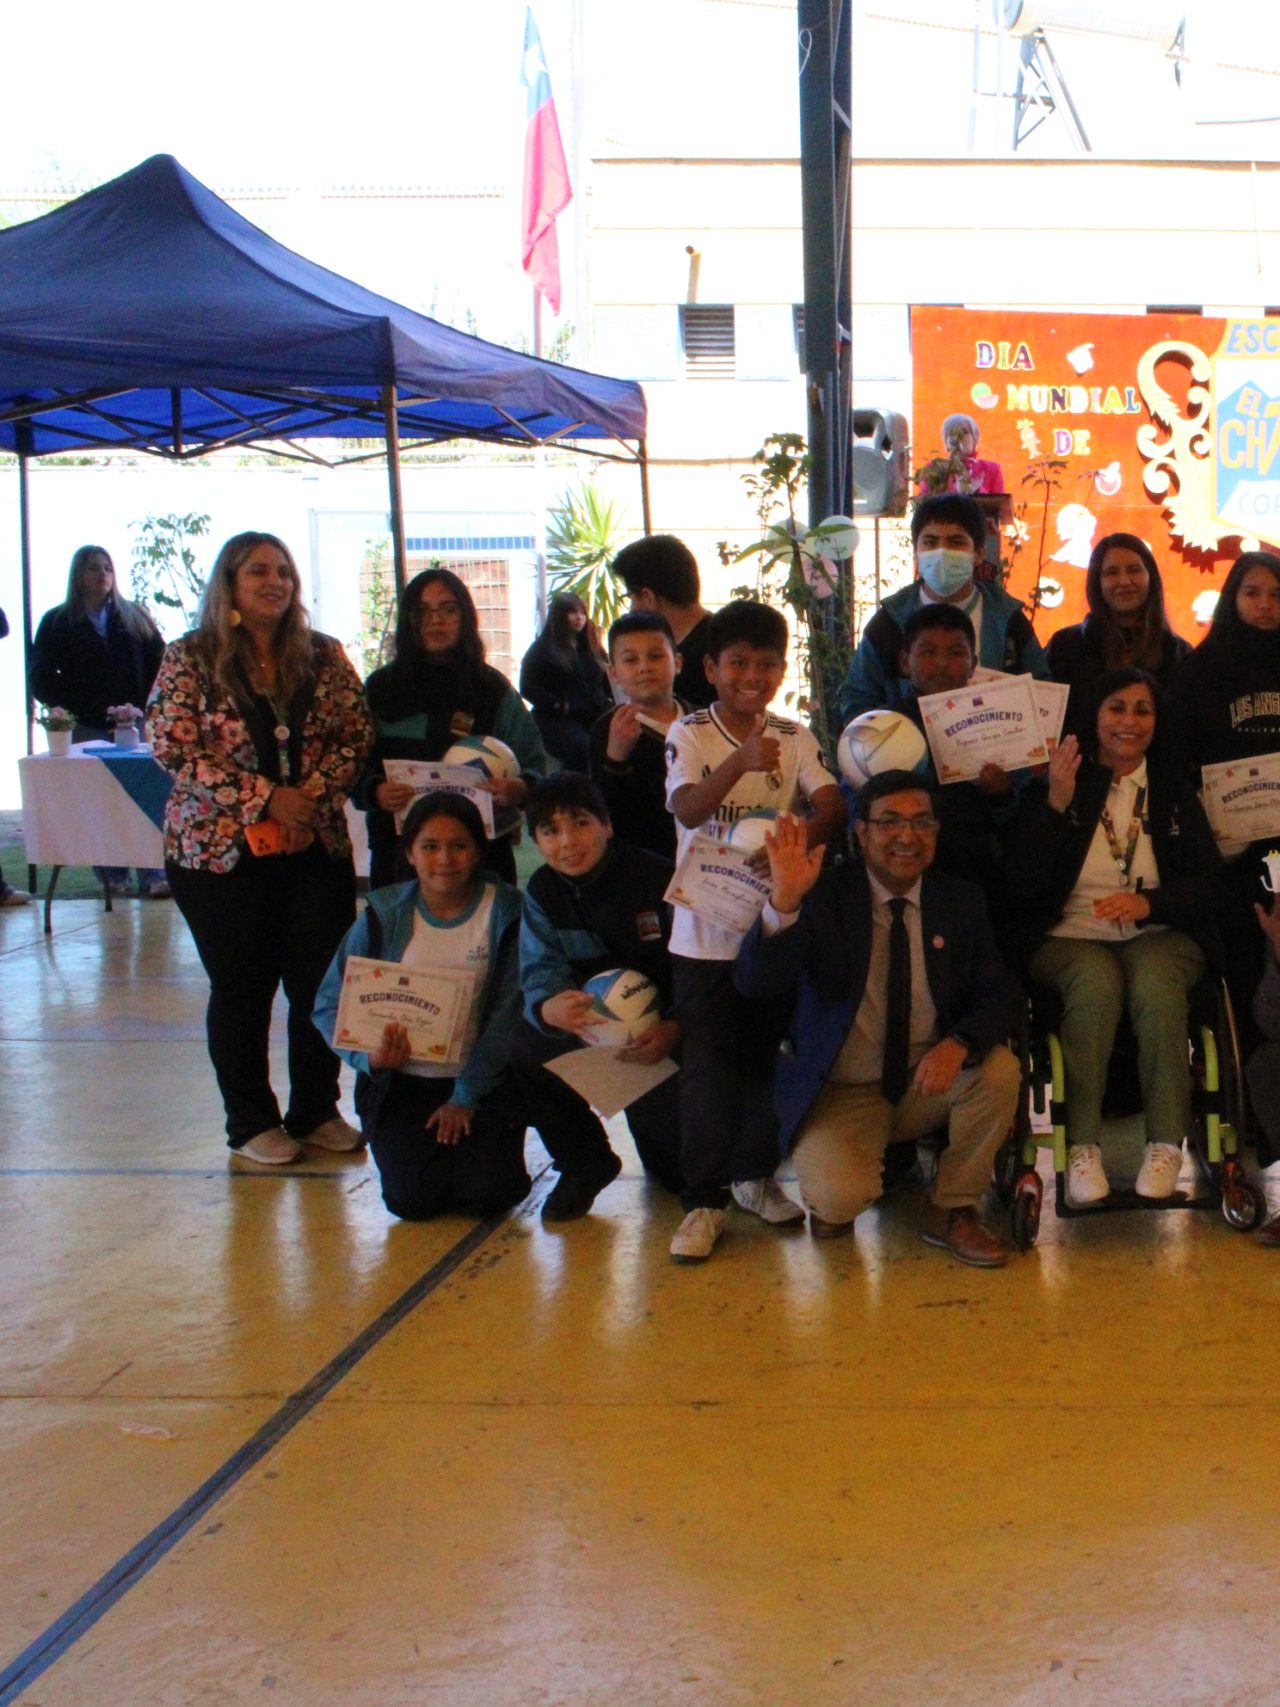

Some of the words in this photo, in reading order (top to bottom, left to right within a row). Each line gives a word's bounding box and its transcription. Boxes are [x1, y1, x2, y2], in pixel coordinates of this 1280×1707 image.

[976, 341, 1034, 370] DIA
[1006, 384, 1141, 413] MUNDIAL
[1236, 387, 1262, 418] EL
[1053, 429, 1090, 455] DE
[944, 711, 1023, 737] RECONOCIMIENTO
[1229, 694, 1253, 728] LOS
[700, 864, 771, 895] RECONOCIMIEN
[360, 992, 440, 1016] RECONOCIMIENTO
